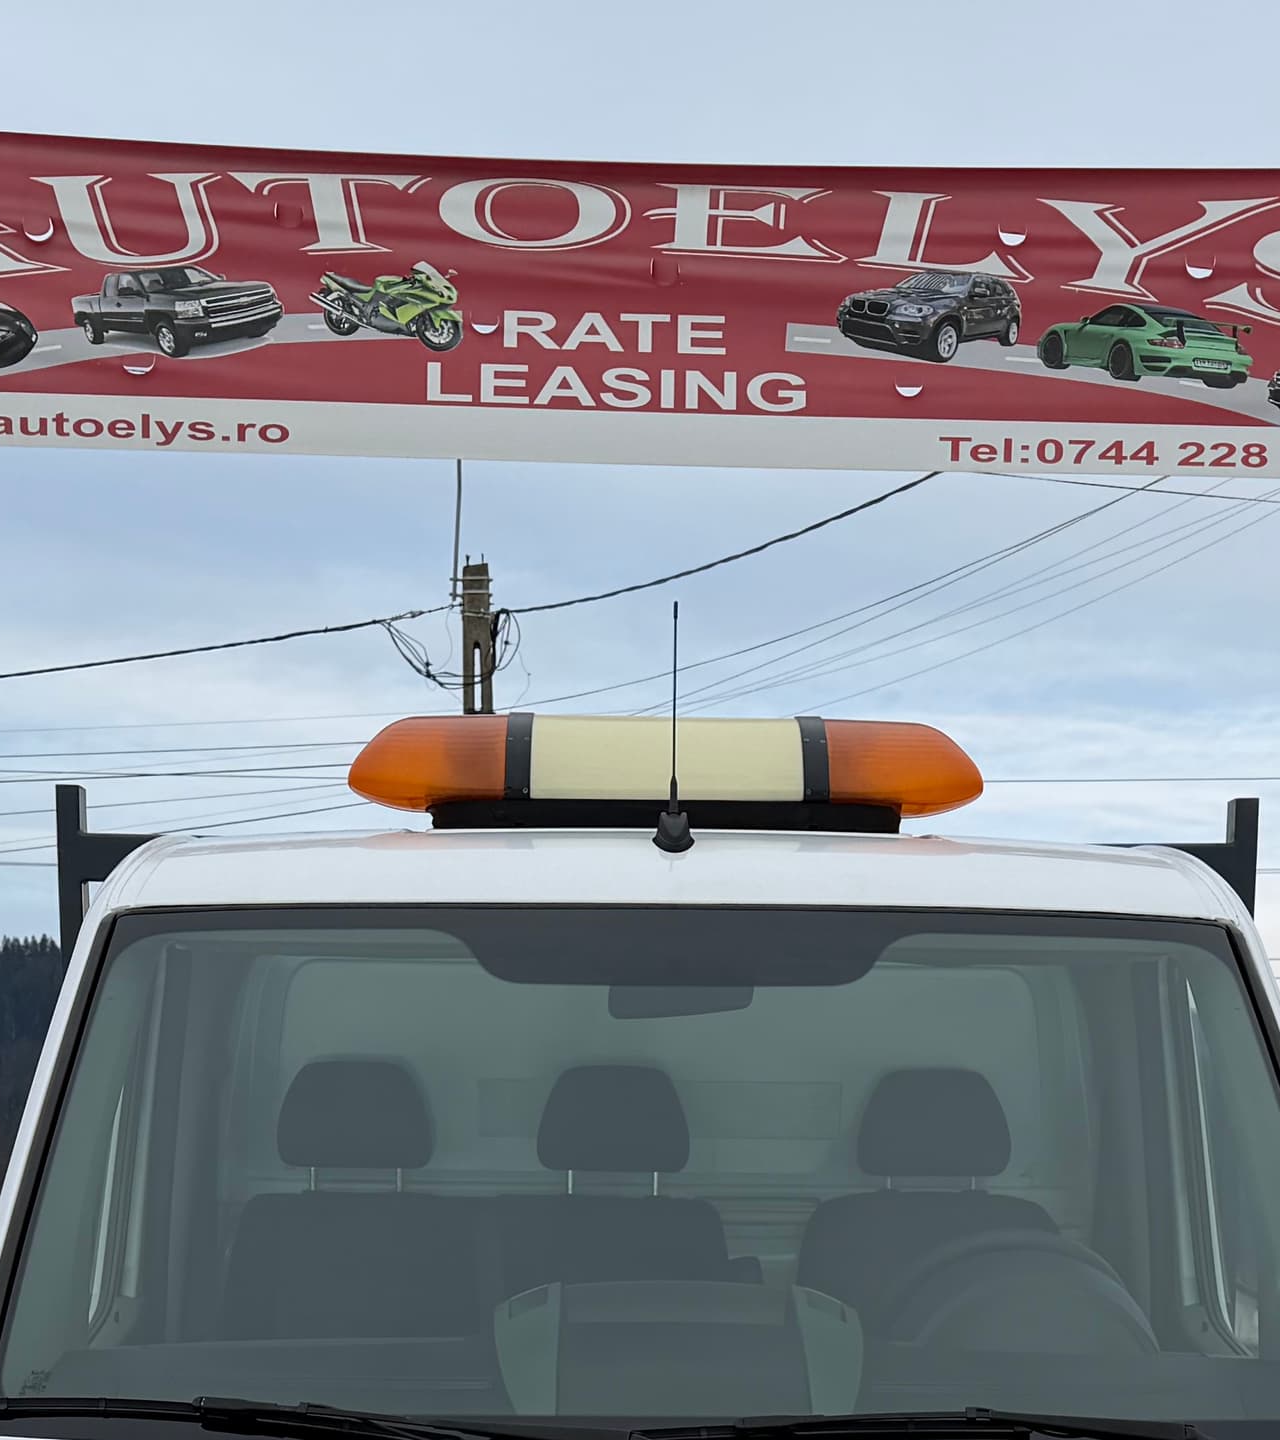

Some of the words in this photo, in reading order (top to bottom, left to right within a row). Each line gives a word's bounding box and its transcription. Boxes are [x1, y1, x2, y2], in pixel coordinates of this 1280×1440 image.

[502, 309, 727, 358] RATE
[425, 363, 808, 412] LEASING
[1177, 441, 1270, 469] 228
